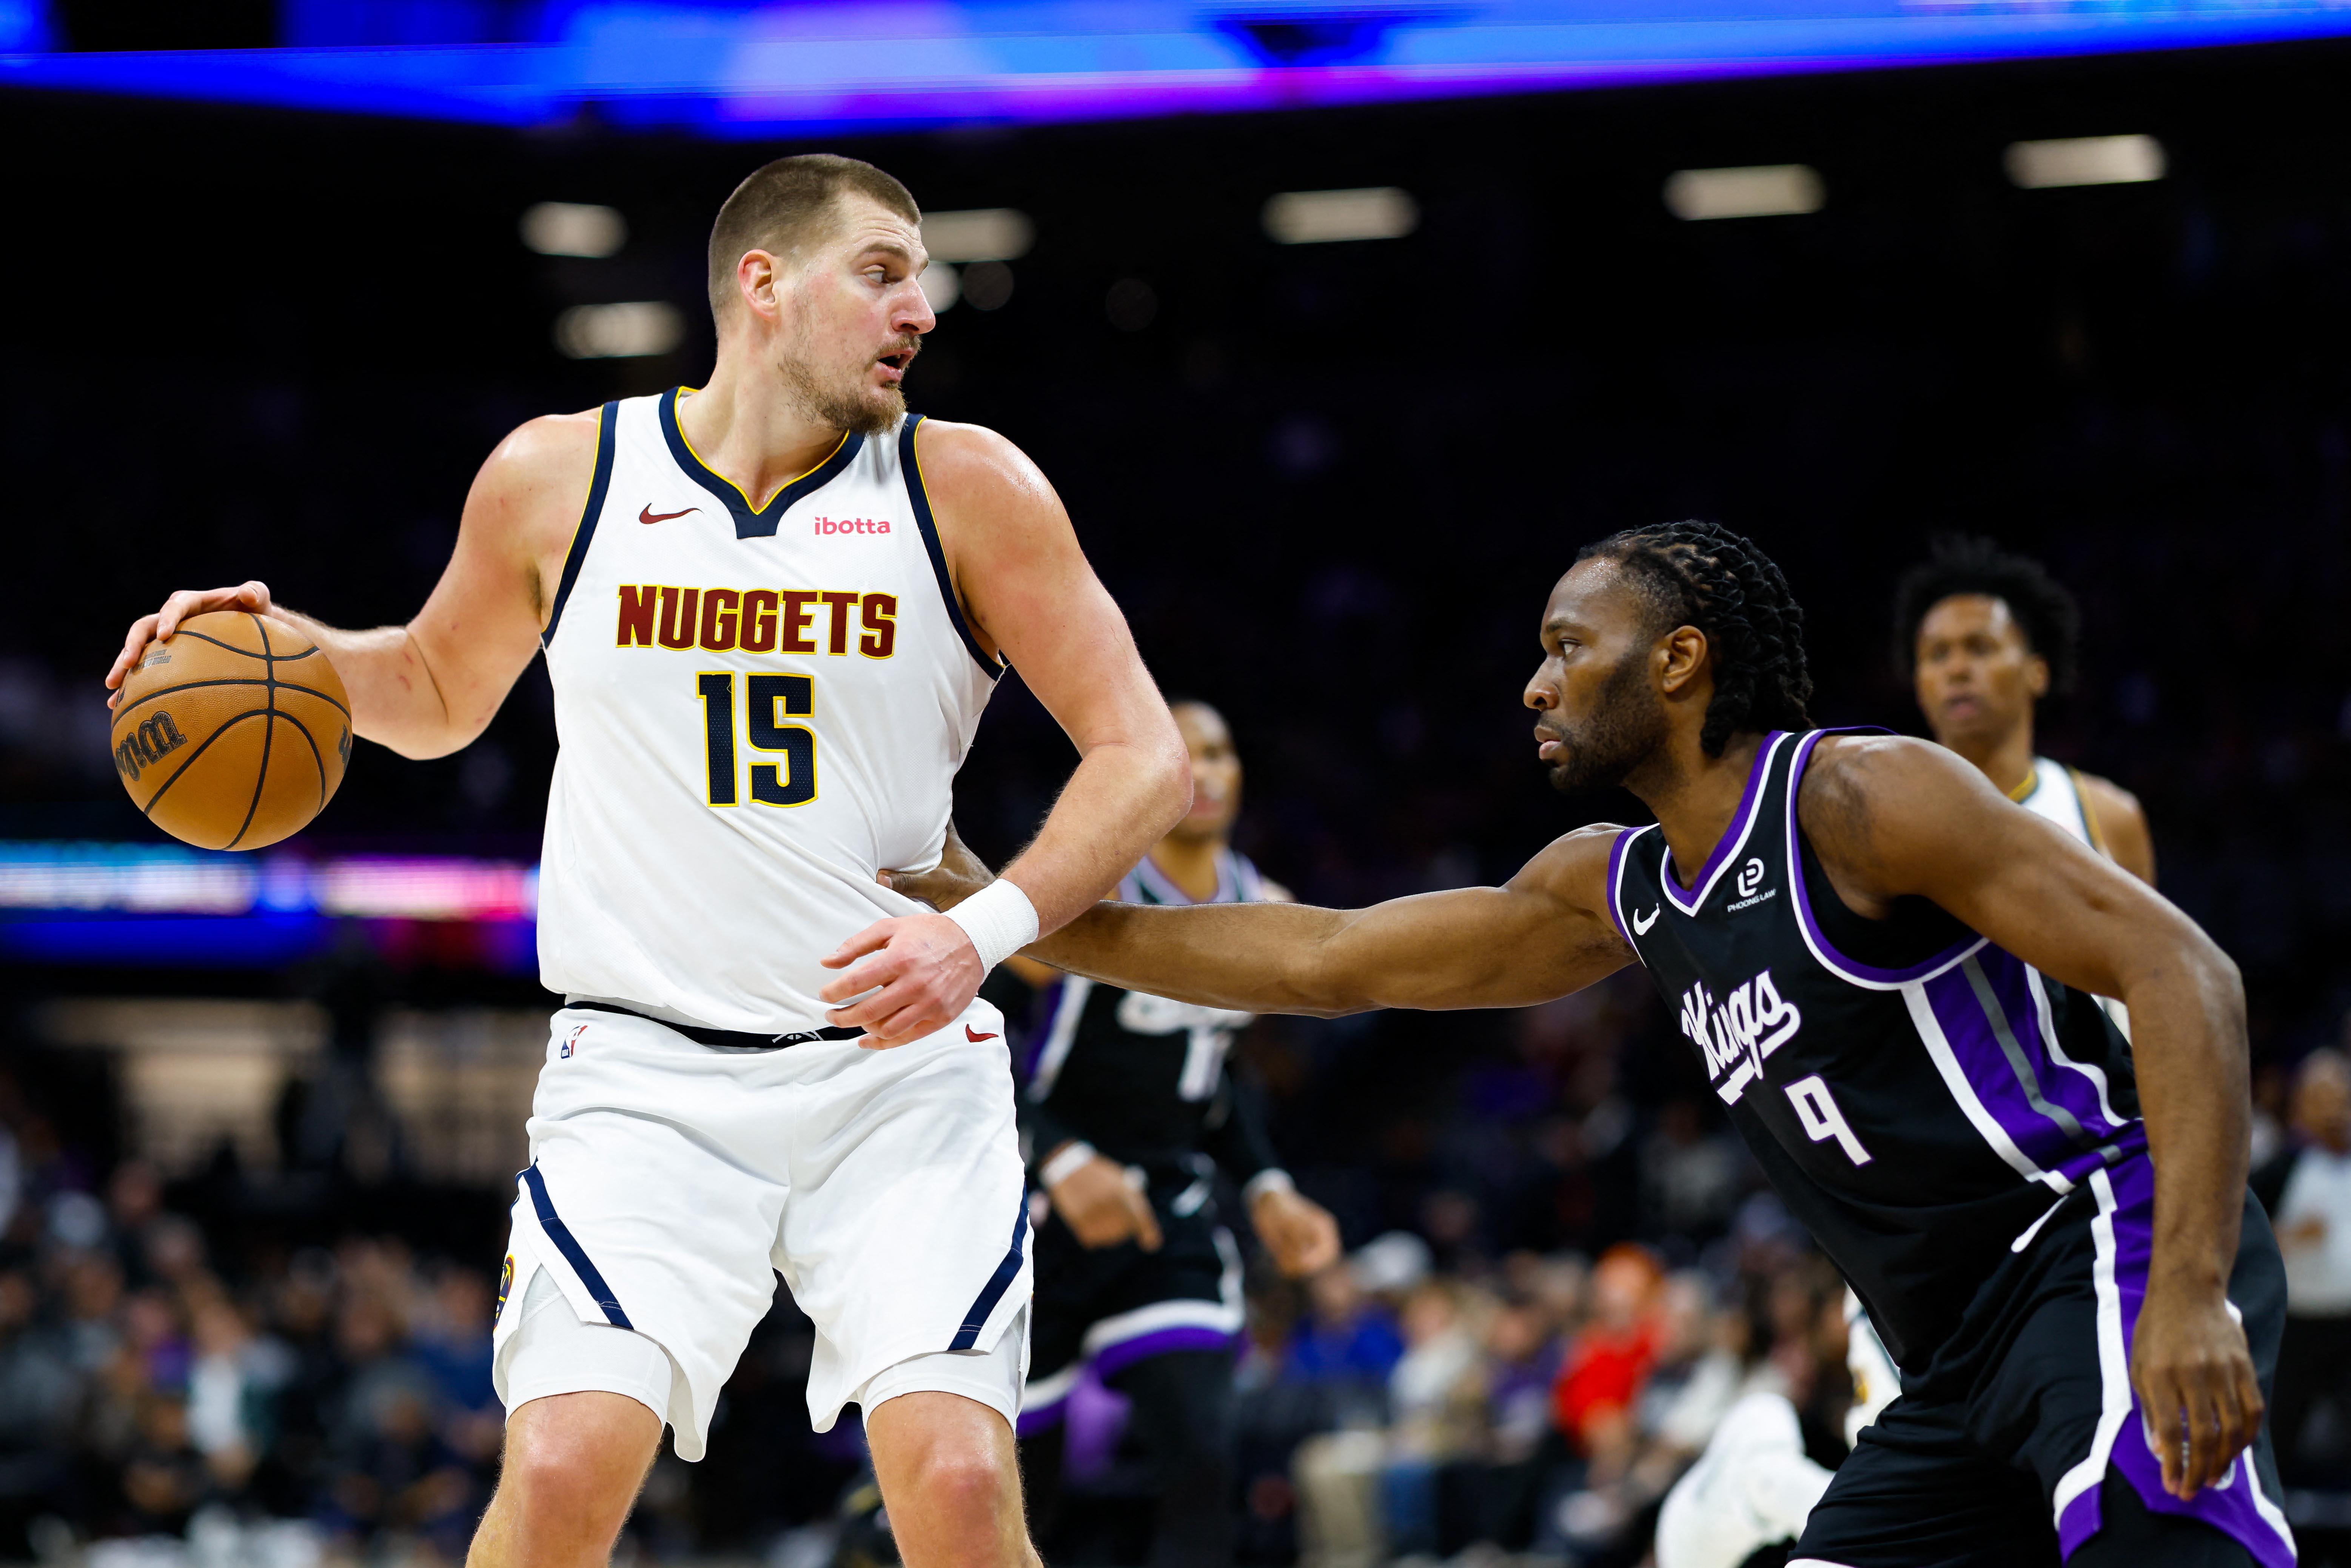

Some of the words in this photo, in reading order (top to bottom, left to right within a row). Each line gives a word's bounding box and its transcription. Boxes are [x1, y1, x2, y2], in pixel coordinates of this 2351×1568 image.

[815, 516, 891, 535] ibotta
[616, 584, 898, 660] NUGGETS
[695, 670, 818, 808] 15
[1727, 895, 1761, 913] PHOONG
[1759, 888, 1776, 901] LAW
[1681, 967, 1801, 1106] Kings
[1780, 1072, 1875, 1169] 9
